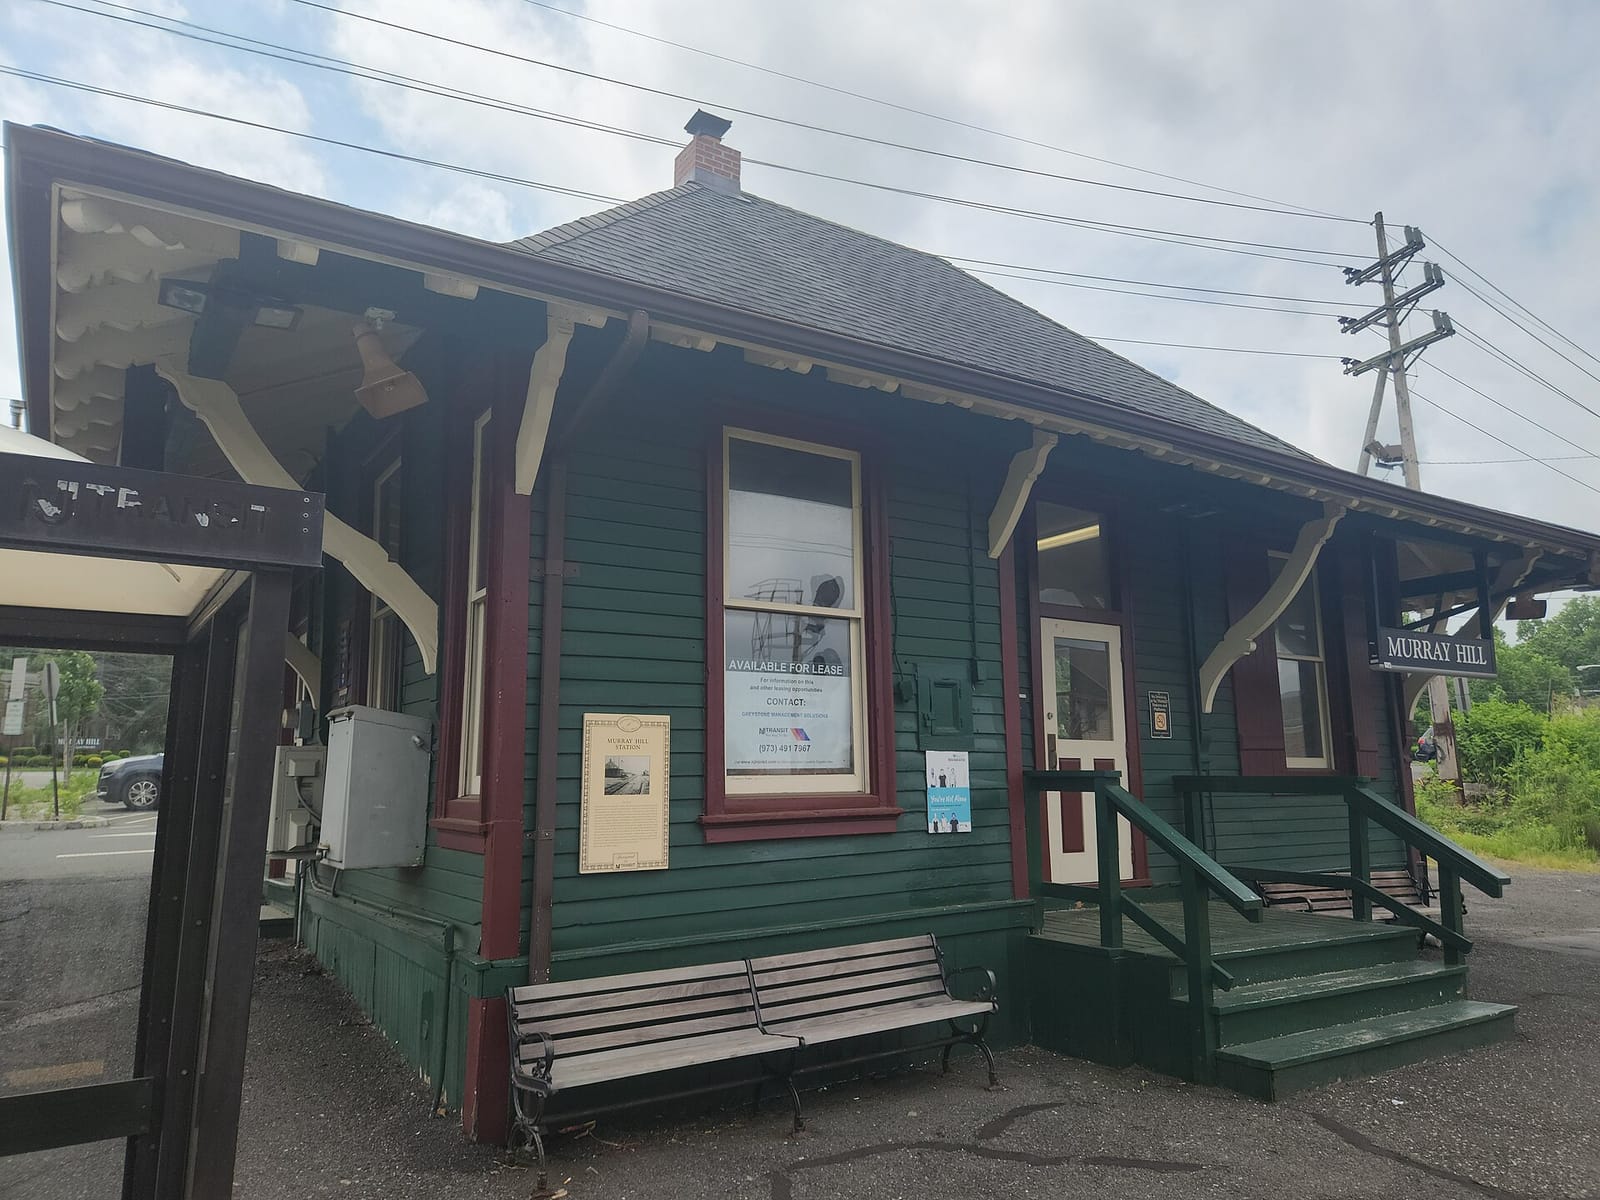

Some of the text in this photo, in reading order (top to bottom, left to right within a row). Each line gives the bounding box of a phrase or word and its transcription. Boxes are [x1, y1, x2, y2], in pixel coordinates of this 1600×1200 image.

[1387, 636, 1487, 664] MURRAY HILL
[728, 659, 843, 675] AVAILABLE FOR LEASE
[766, 697, 806, 706] CONTACT:
[759, 744, 778, 754] (973)
[778, 744, 792, 752] 491
